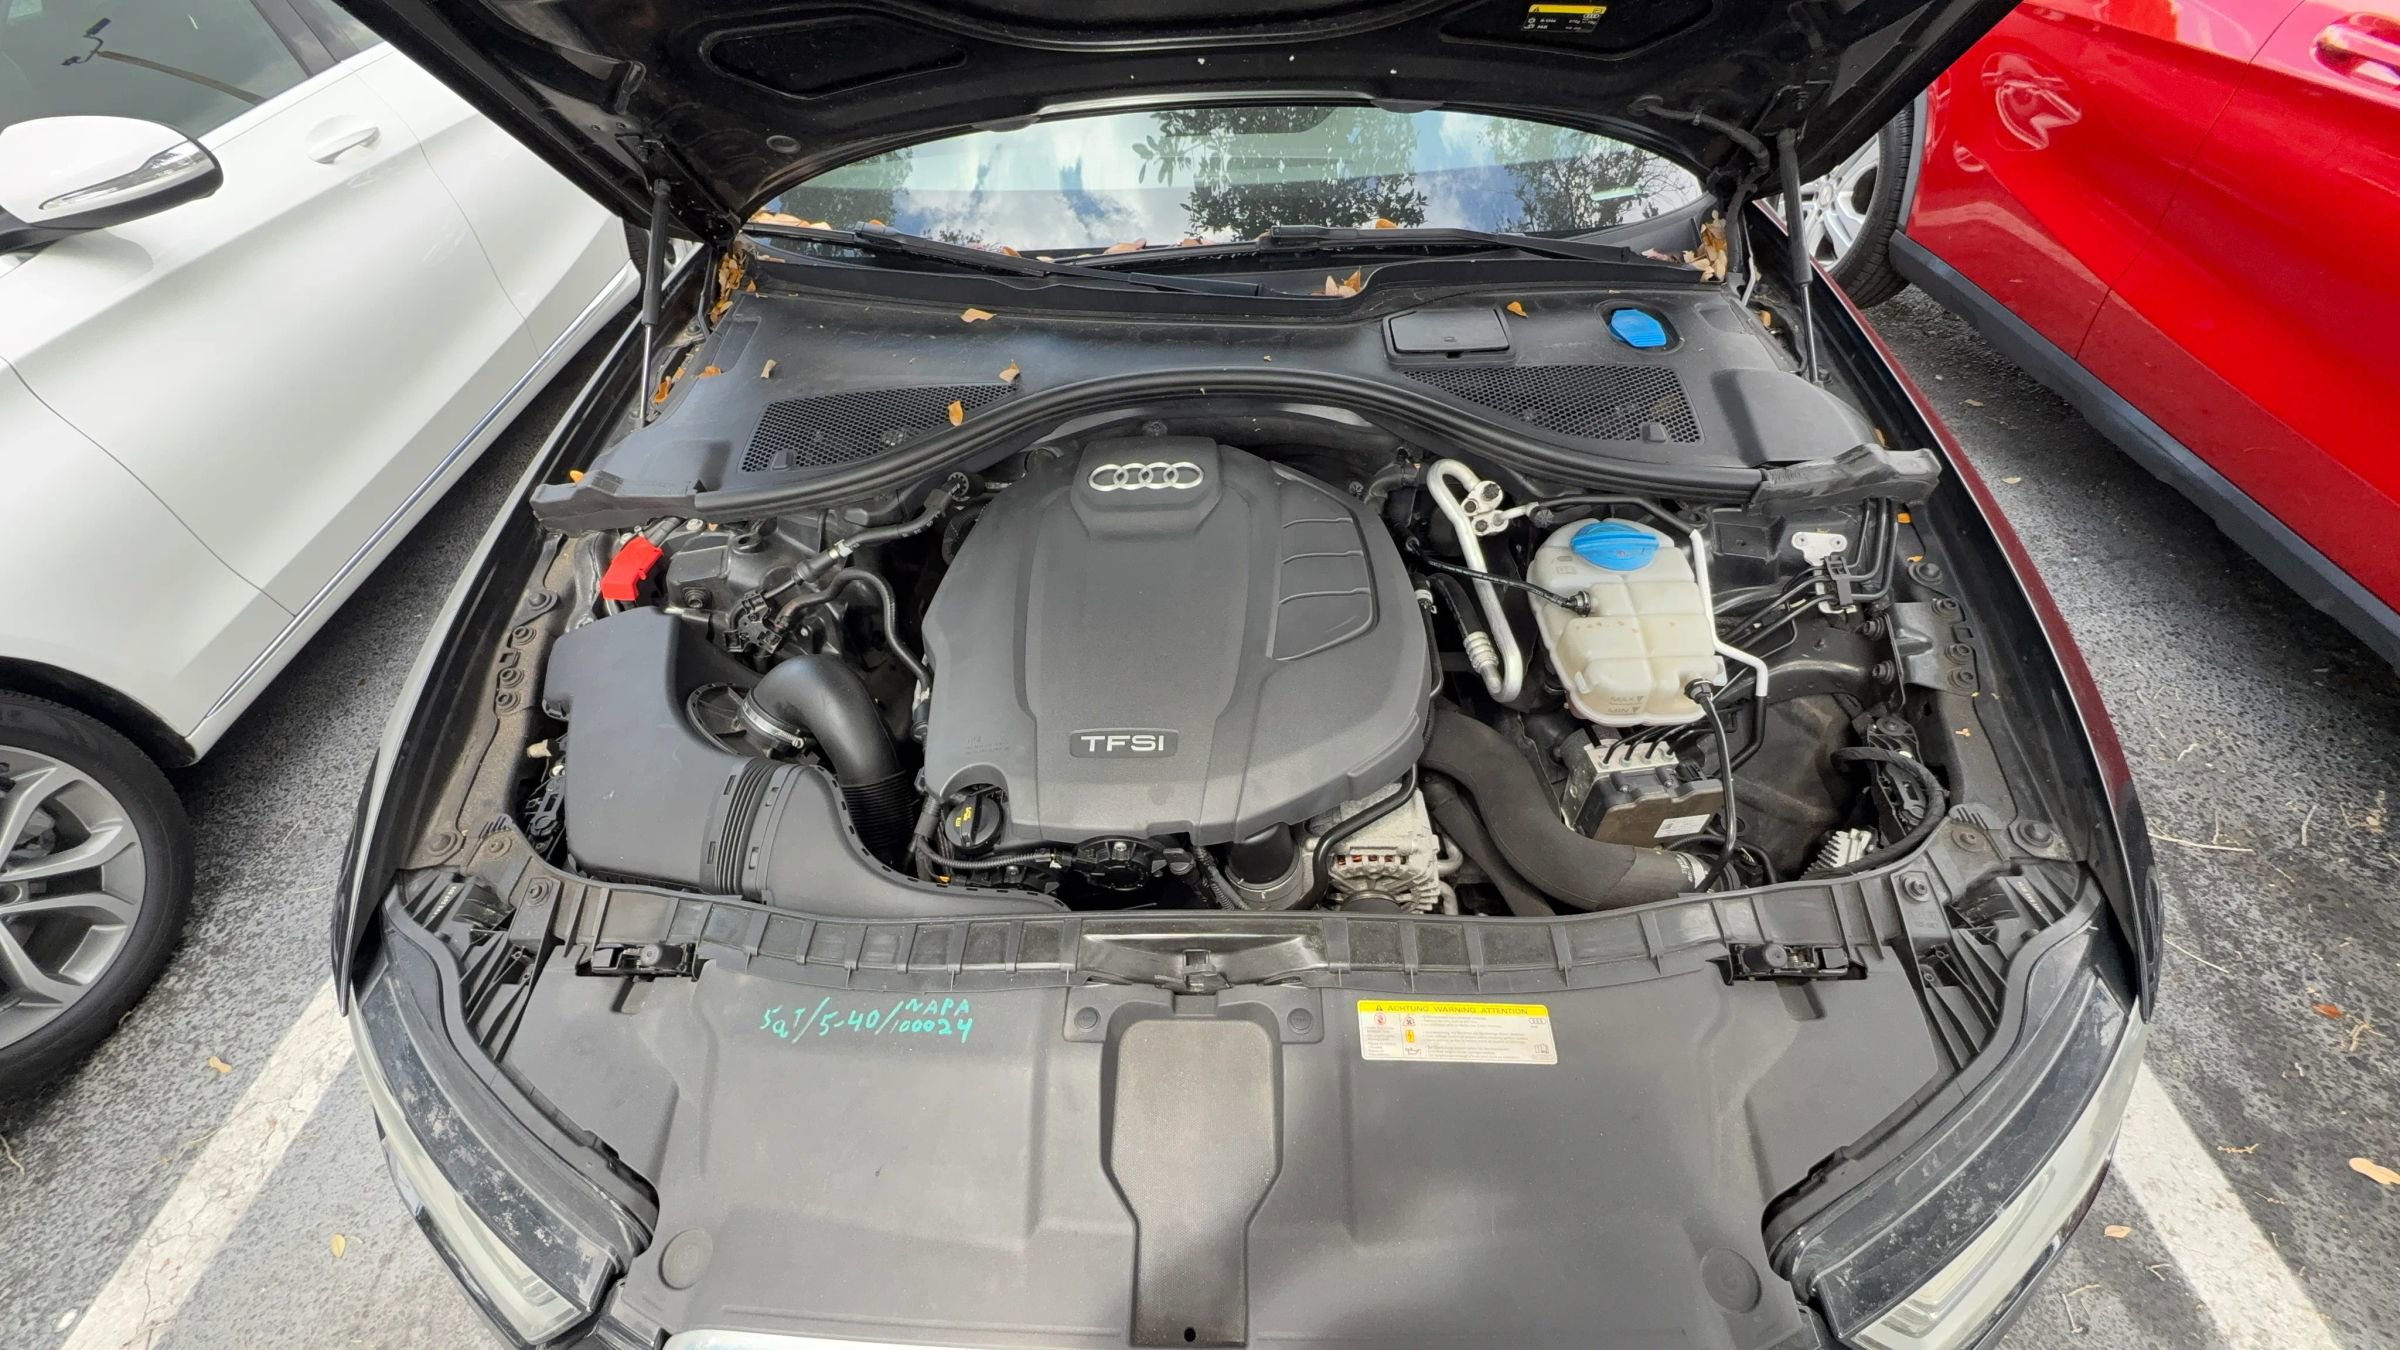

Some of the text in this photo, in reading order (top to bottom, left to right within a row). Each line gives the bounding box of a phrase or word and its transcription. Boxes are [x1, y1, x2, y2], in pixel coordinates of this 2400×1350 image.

[1081, 735, 1164, 752] TFSI
[905, 998, 970, 1017] NAPA
[1387, 1004, 1528, 1015] ACHTUNG WARNING ATTENTION
